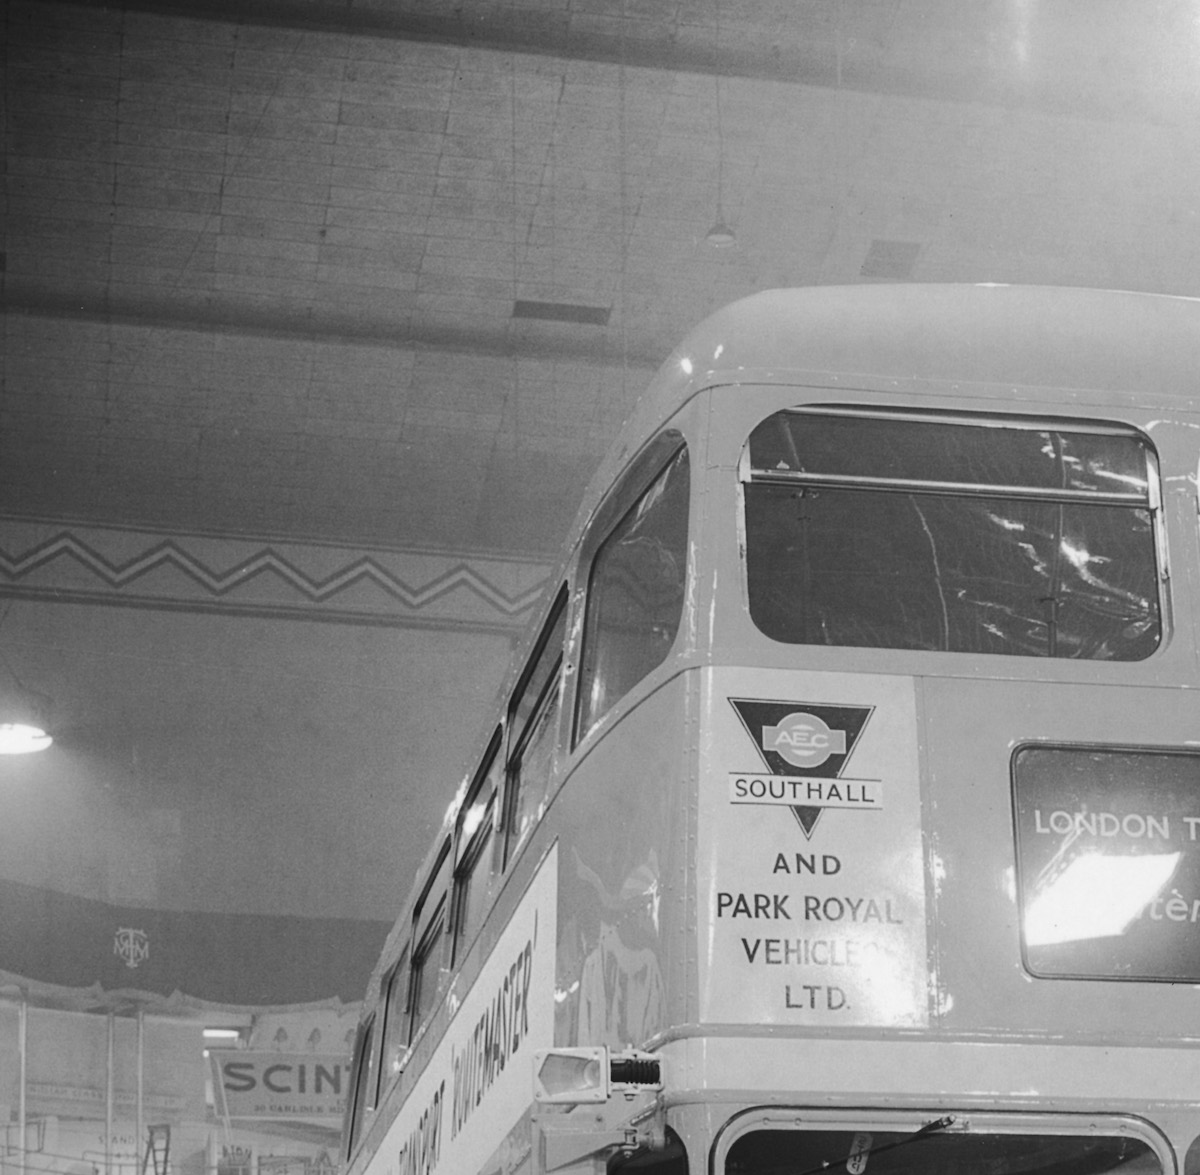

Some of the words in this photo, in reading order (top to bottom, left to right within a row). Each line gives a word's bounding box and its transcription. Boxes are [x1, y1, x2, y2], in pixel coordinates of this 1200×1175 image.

[774, 729, 830, 749] AEC
[735, 778, 876, 804] SOUTHALL
[1034, 809, 1170, 840] LONDON
[772, 852, 842, 876] AND
[717, 892, 791, 920] PARK
[804, 896, 903, 926] ROYAL
[785, 984, 851, 1011] LTD.
